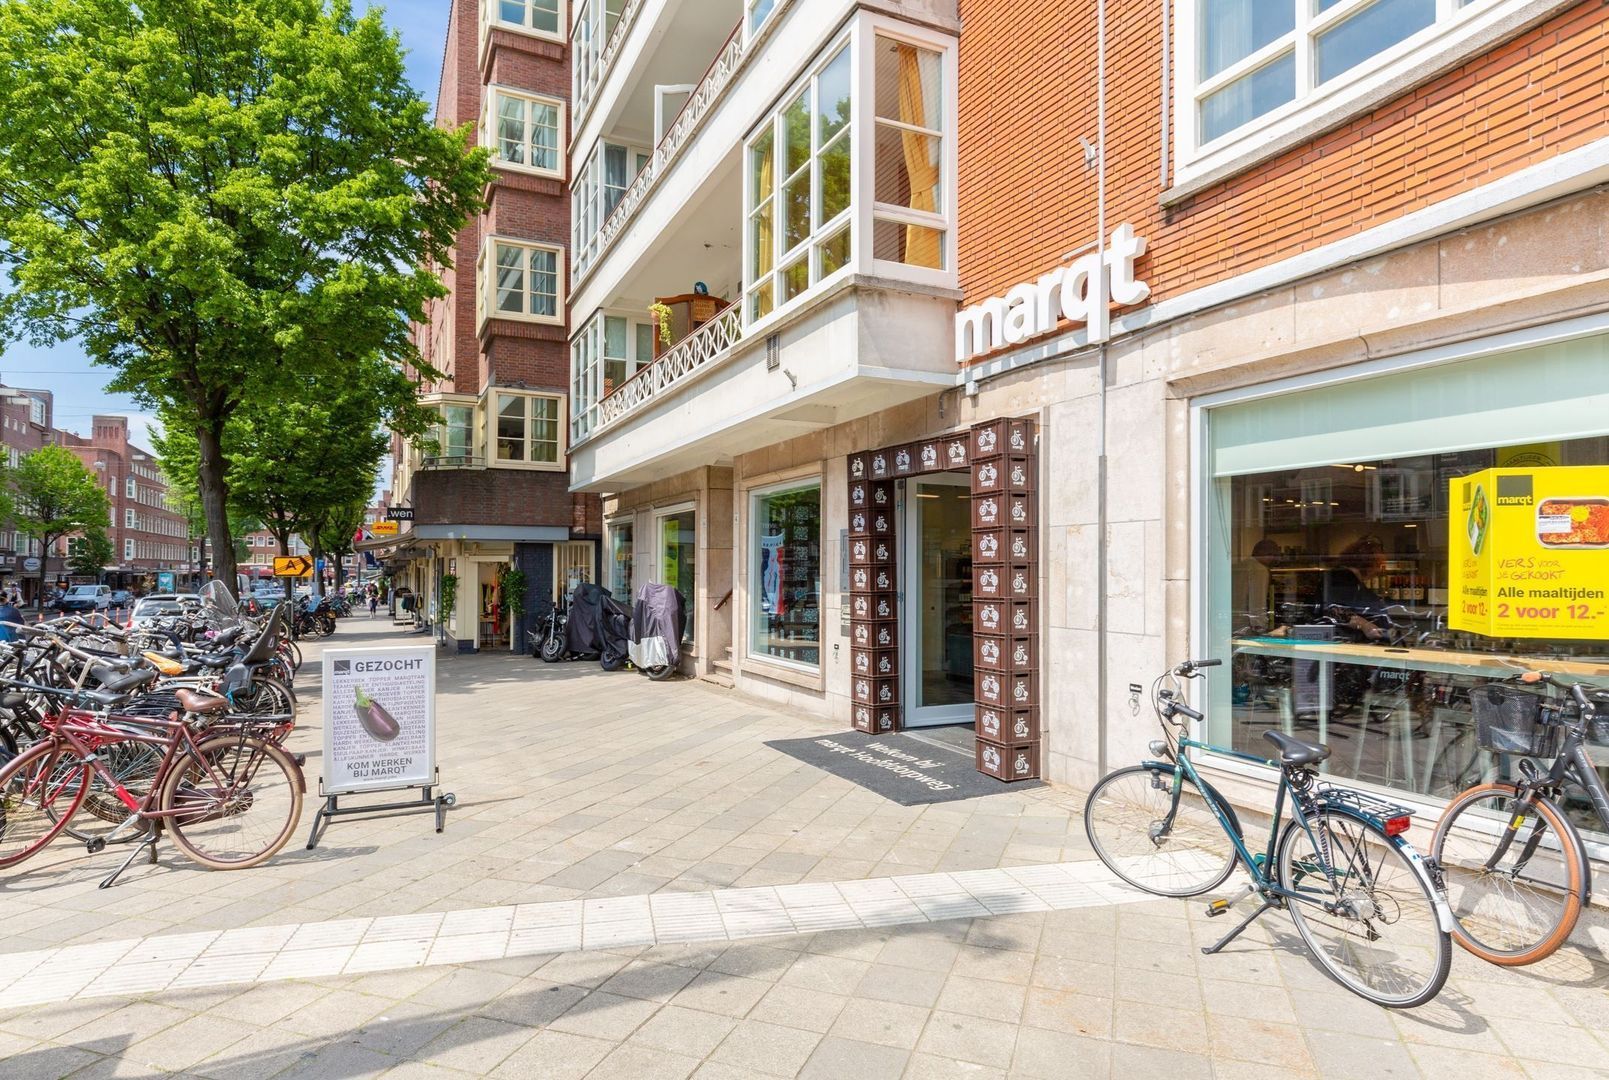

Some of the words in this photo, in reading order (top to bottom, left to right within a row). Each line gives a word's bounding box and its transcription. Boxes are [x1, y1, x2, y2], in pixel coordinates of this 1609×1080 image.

[955, 222, 1150, 361] marqt
[1498, 495, 1533, 505] marqt
[286, 560, 297, 570] A
[1498, 557, 1536, 568] VERS
[1510, 570, 1565, 580] GEKOOKT
[1497, 587, 1525, 597] Alle
[1529, 587, 1604, 601] maaltijden
[1498, 603, 1510, 617] 2
[1516, 607, 1559, 618] voor
[1567, 604, 1604, 619] 12.-
[355, 659, 423, 672] GEZOCHT
[1380, 670, 1410, 682] marqt
[865, 742, 918, 763] Welkom
[347, 761, 369, 770] KOM
[372, 757, 412, 767] WERKEN
[371, 765, 407, 776] MARQT
